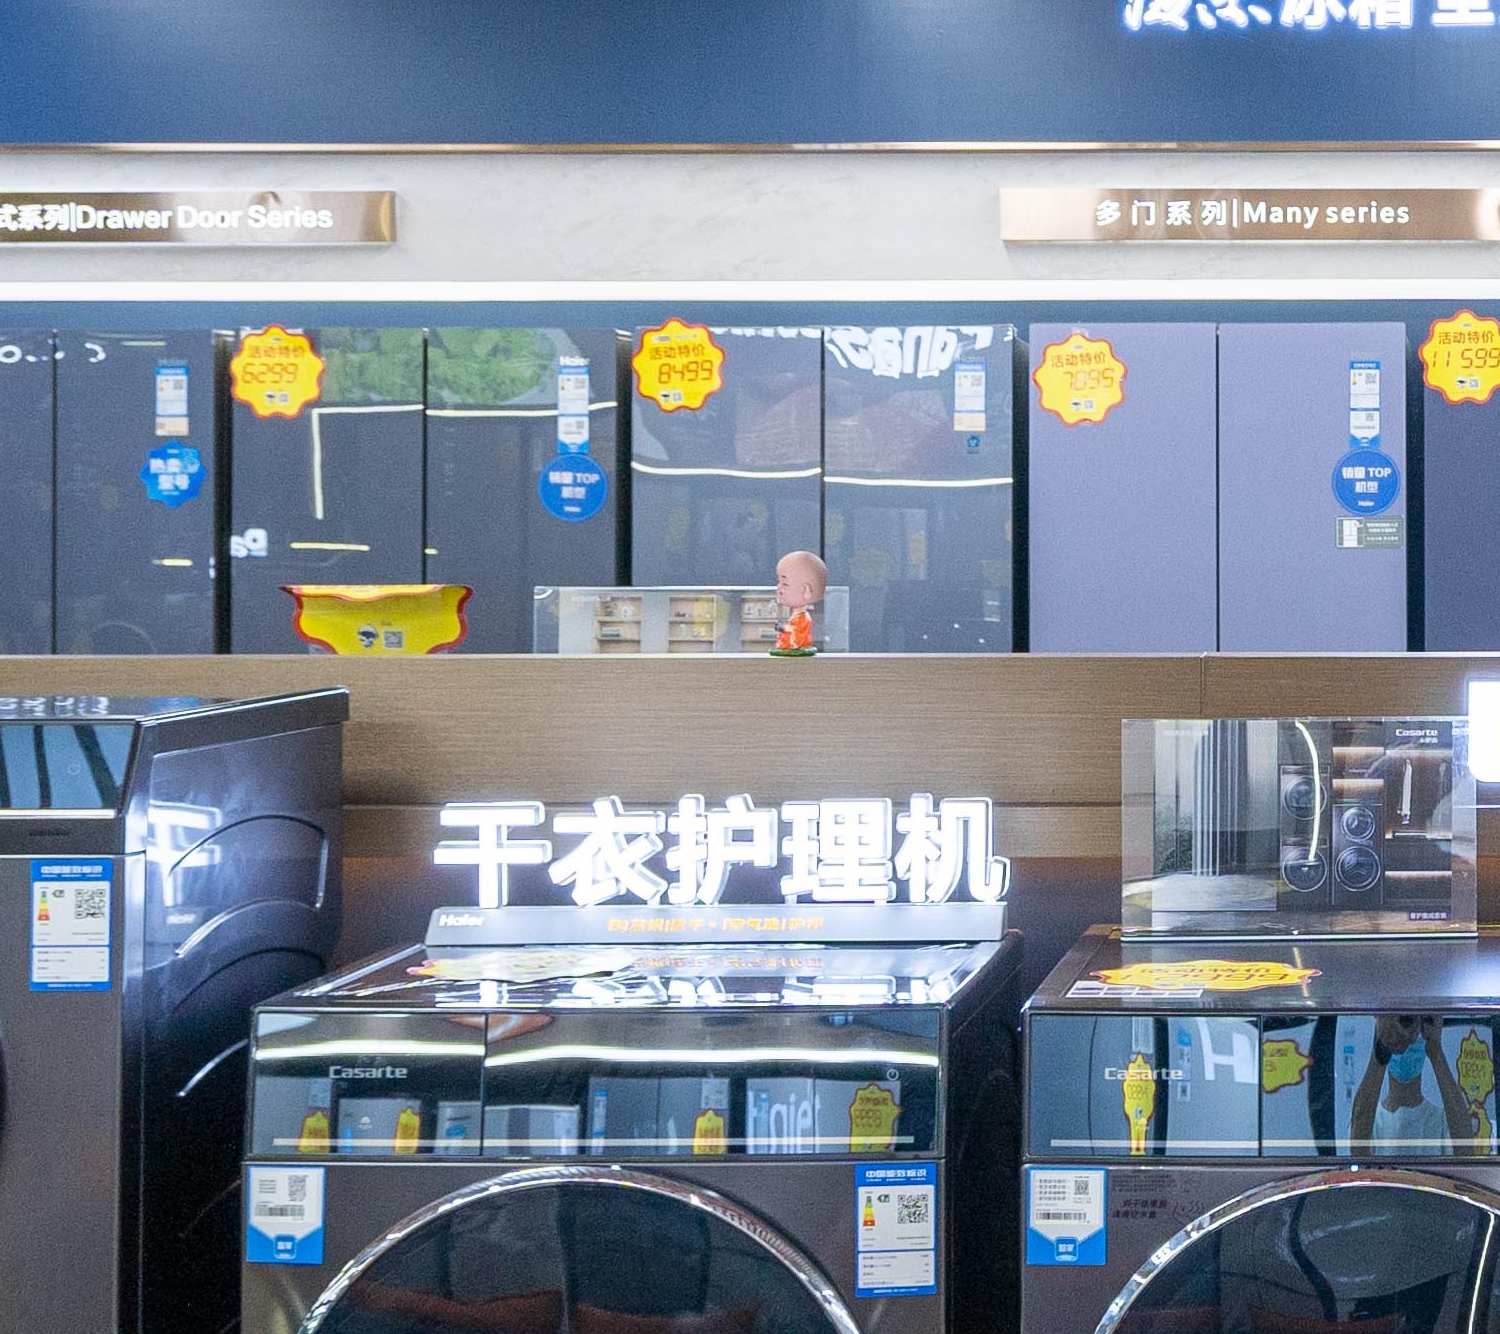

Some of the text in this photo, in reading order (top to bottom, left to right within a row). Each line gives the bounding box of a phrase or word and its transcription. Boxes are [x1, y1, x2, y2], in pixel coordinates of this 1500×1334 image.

[178, 204, 241, 230] Door
[248, 203, 334, 230] Series
[1325, 200, 1410, 225] series
[1438, 330, 1494, 344] 活动特价
[249, 345, 305, 359] 活动特价
[650, 344, 706, 359] 活动特价
[1050, 352, 1107, 368] 活动特价
[658, 360, 713, 384] 8499
[576, 472, 601, 484] TOP
[1368, 467, 1392, 479] TOP
[1395, 729, 1438, 738] Casarte
[433, 793, 1012, 908] 干衣护理机
[439, 913, 486, 927] Haier
[329, 1064, 408, 1080] Casarte
[1104, 1067, 1183, 1081] Casarte
